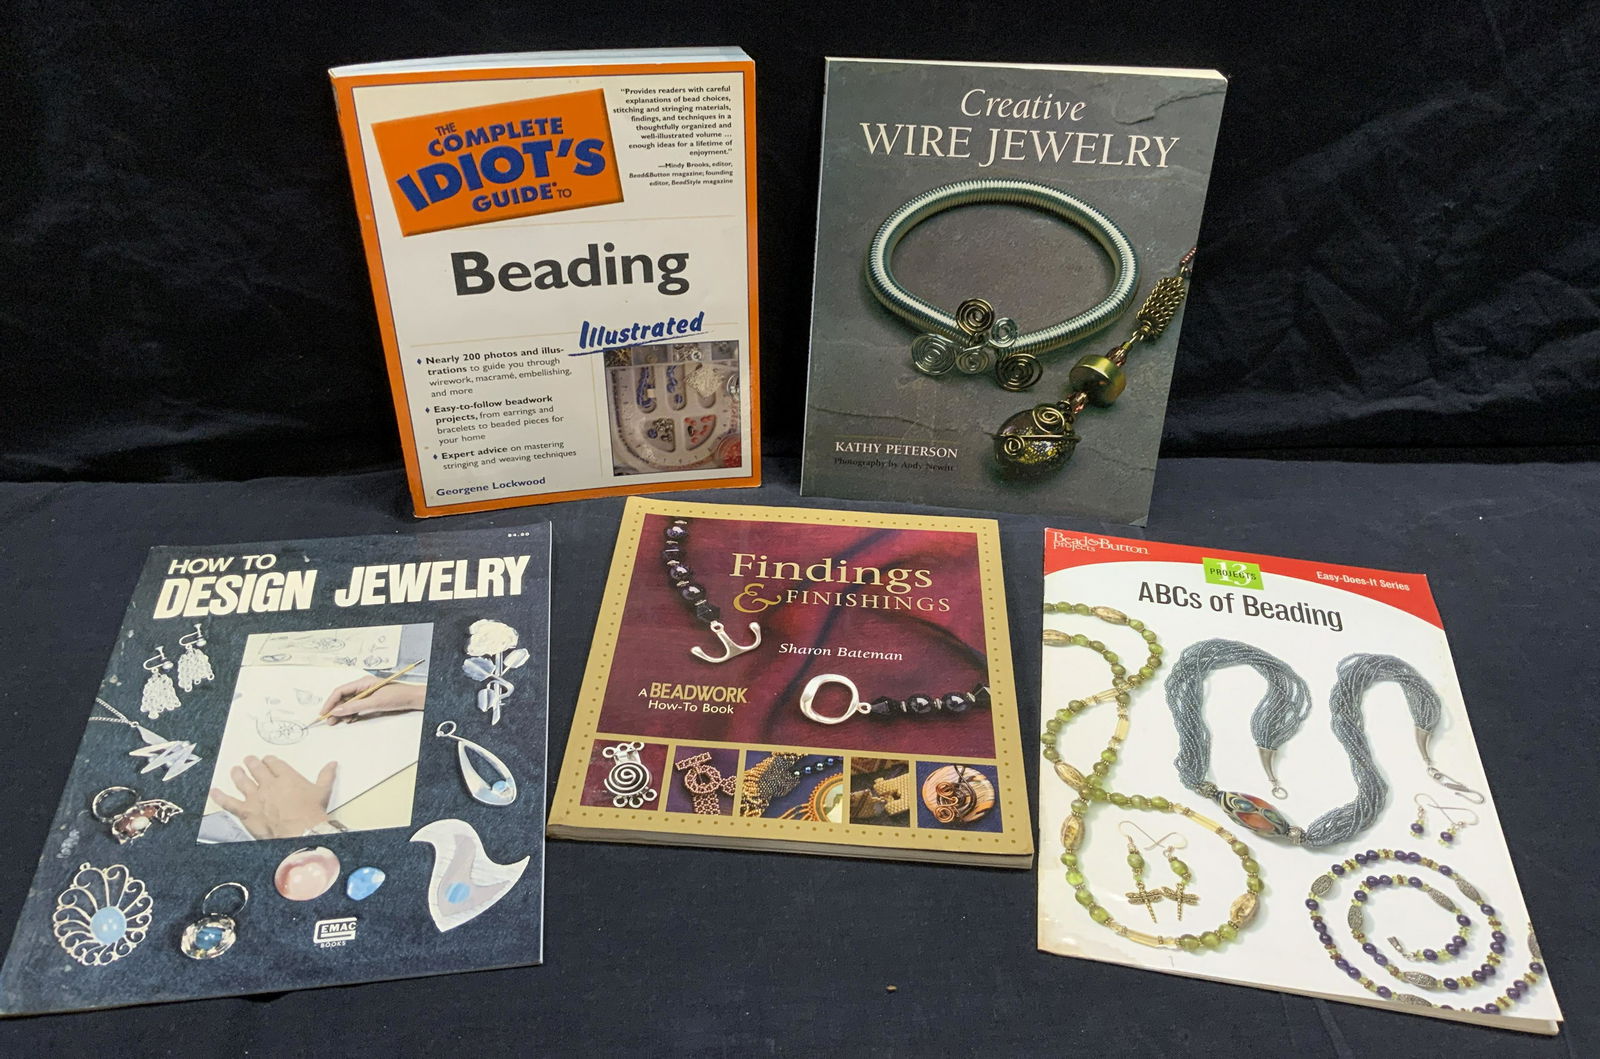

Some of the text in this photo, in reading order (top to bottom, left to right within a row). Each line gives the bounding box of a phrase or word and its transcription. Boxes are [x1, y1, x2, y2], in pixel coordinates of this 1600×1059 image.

[662, 105, 693, 113] stringing
[960, 88, 1088, 122] Creative
[428, 117, 563, 157] COMPLETE
[435, 122, 457, 136] THE
[859, 122, 1180, 169] WIRE JEWELRY
[396, 139, 606, 212] IDIOT'S
[557, 188, 572, 199] TO
[451, 242, 690, 296] Beading
[579, 311, 705, 350] Illustrated
[426, 347, 564, 365] Nearly 200 photos and illus-
[428, 367, 467, 375] trations
[483, 363, 506, 372] guide
[509, 361, 524, 369] you
[527, 358, 560, 366] through
[429, 369, 572, 386] wirework, macramé, embellishing,
[431, 388, 473, 397] and more
[434, 395, 553, 413] Easy-to-follow beadwork
[435, 414, 478, 425] projects,
[480, 411, 500, 419] from
[503, 409, 536, 417] earrings
[437, 424, 476, 434] bracelets
[491, 420, 521, 428] beaded
[524, 417, 549, 426] pieces
[439, 433, 486, 446] your home
[442, 451, 475, 461] Expert
[478, 446, 508, 456] advice
[524, 441, 564, 450] mastering
[835, 442, 958, 458] KATHY PETERSON
[443, 450, 577, 470] stringing and weaving techniques
[834, 458, 886, 468] Photography
[888, 460, 898, 468] by
[436, 477, 546, 496] Georgene Lockwood
[168, 553, 277, 575] HOW TO
[729, 553, 934, 595] Findings
[1210, 567, 1257, 580] PROJECTS
[1316, 571, 1411, 591] Easy-Does-It Series
[152, 554, 532, 620] DESIGN JEWELRY
[732, 583, 951, 614] & FINISHINGS
[1138, 581, 1343, 632] ABCs of Beading
[778, 643, 903, 661] Sharon Bateman
[638, 682, 749, 704] A BEADWORK
[648, 700, 735, 715] How-To Book
[321, 922, 357, 933] EMAC
